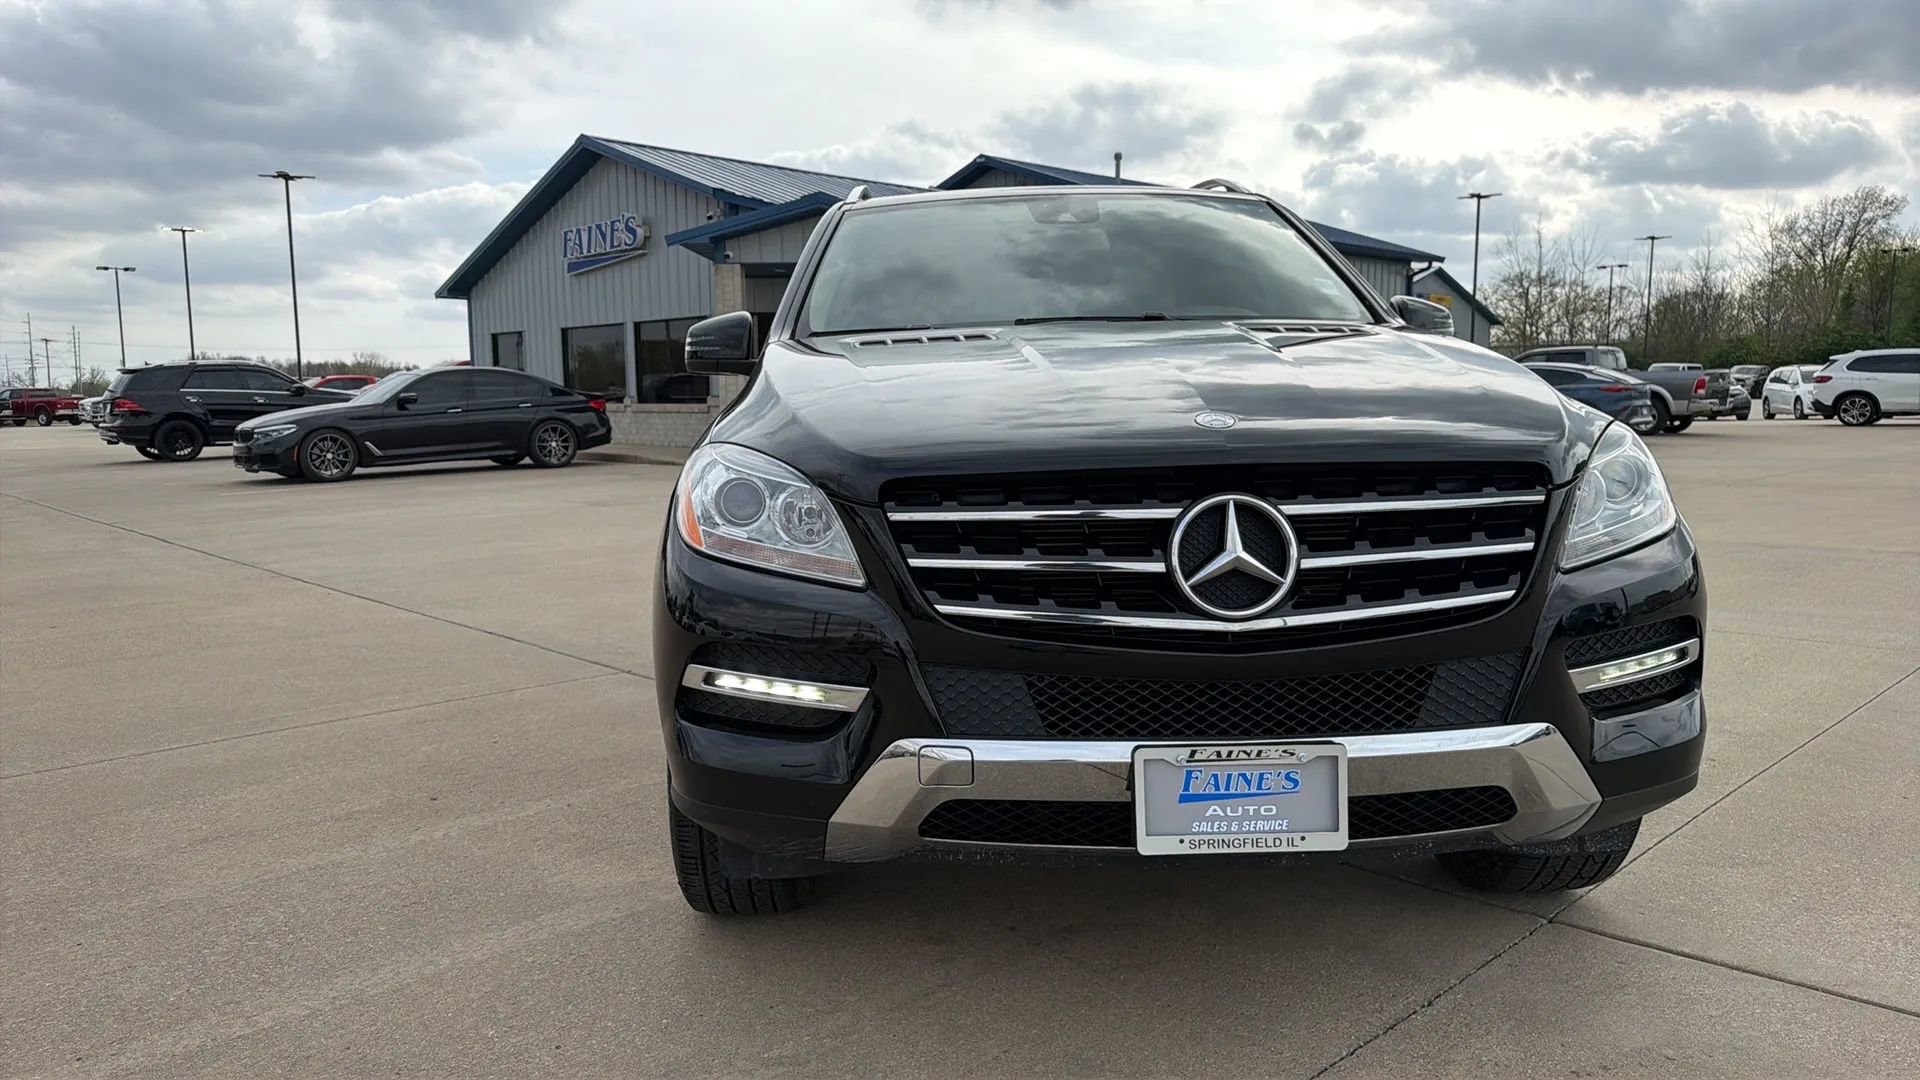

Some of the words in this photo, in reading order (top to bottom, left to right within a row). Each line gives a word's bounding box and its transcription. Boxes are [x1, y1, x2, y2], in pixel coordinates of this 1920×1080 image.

[560, 213, 639, 259] FAINE'S
[1188, 748, 1296, 760] FAINE'S
[1181, 768, 1300, 793] FAINE'S
[1205, 805, 1277, 816] AUTO
[1192, 820, 1227, 832] SALES
[1231, 821, 1239, 831] &
[1242, 819, 1289, 831] SERVICE
[1188, 837, 1282, 849] SPRINGFIELD
[1286, 836, 1299, 847] IL
